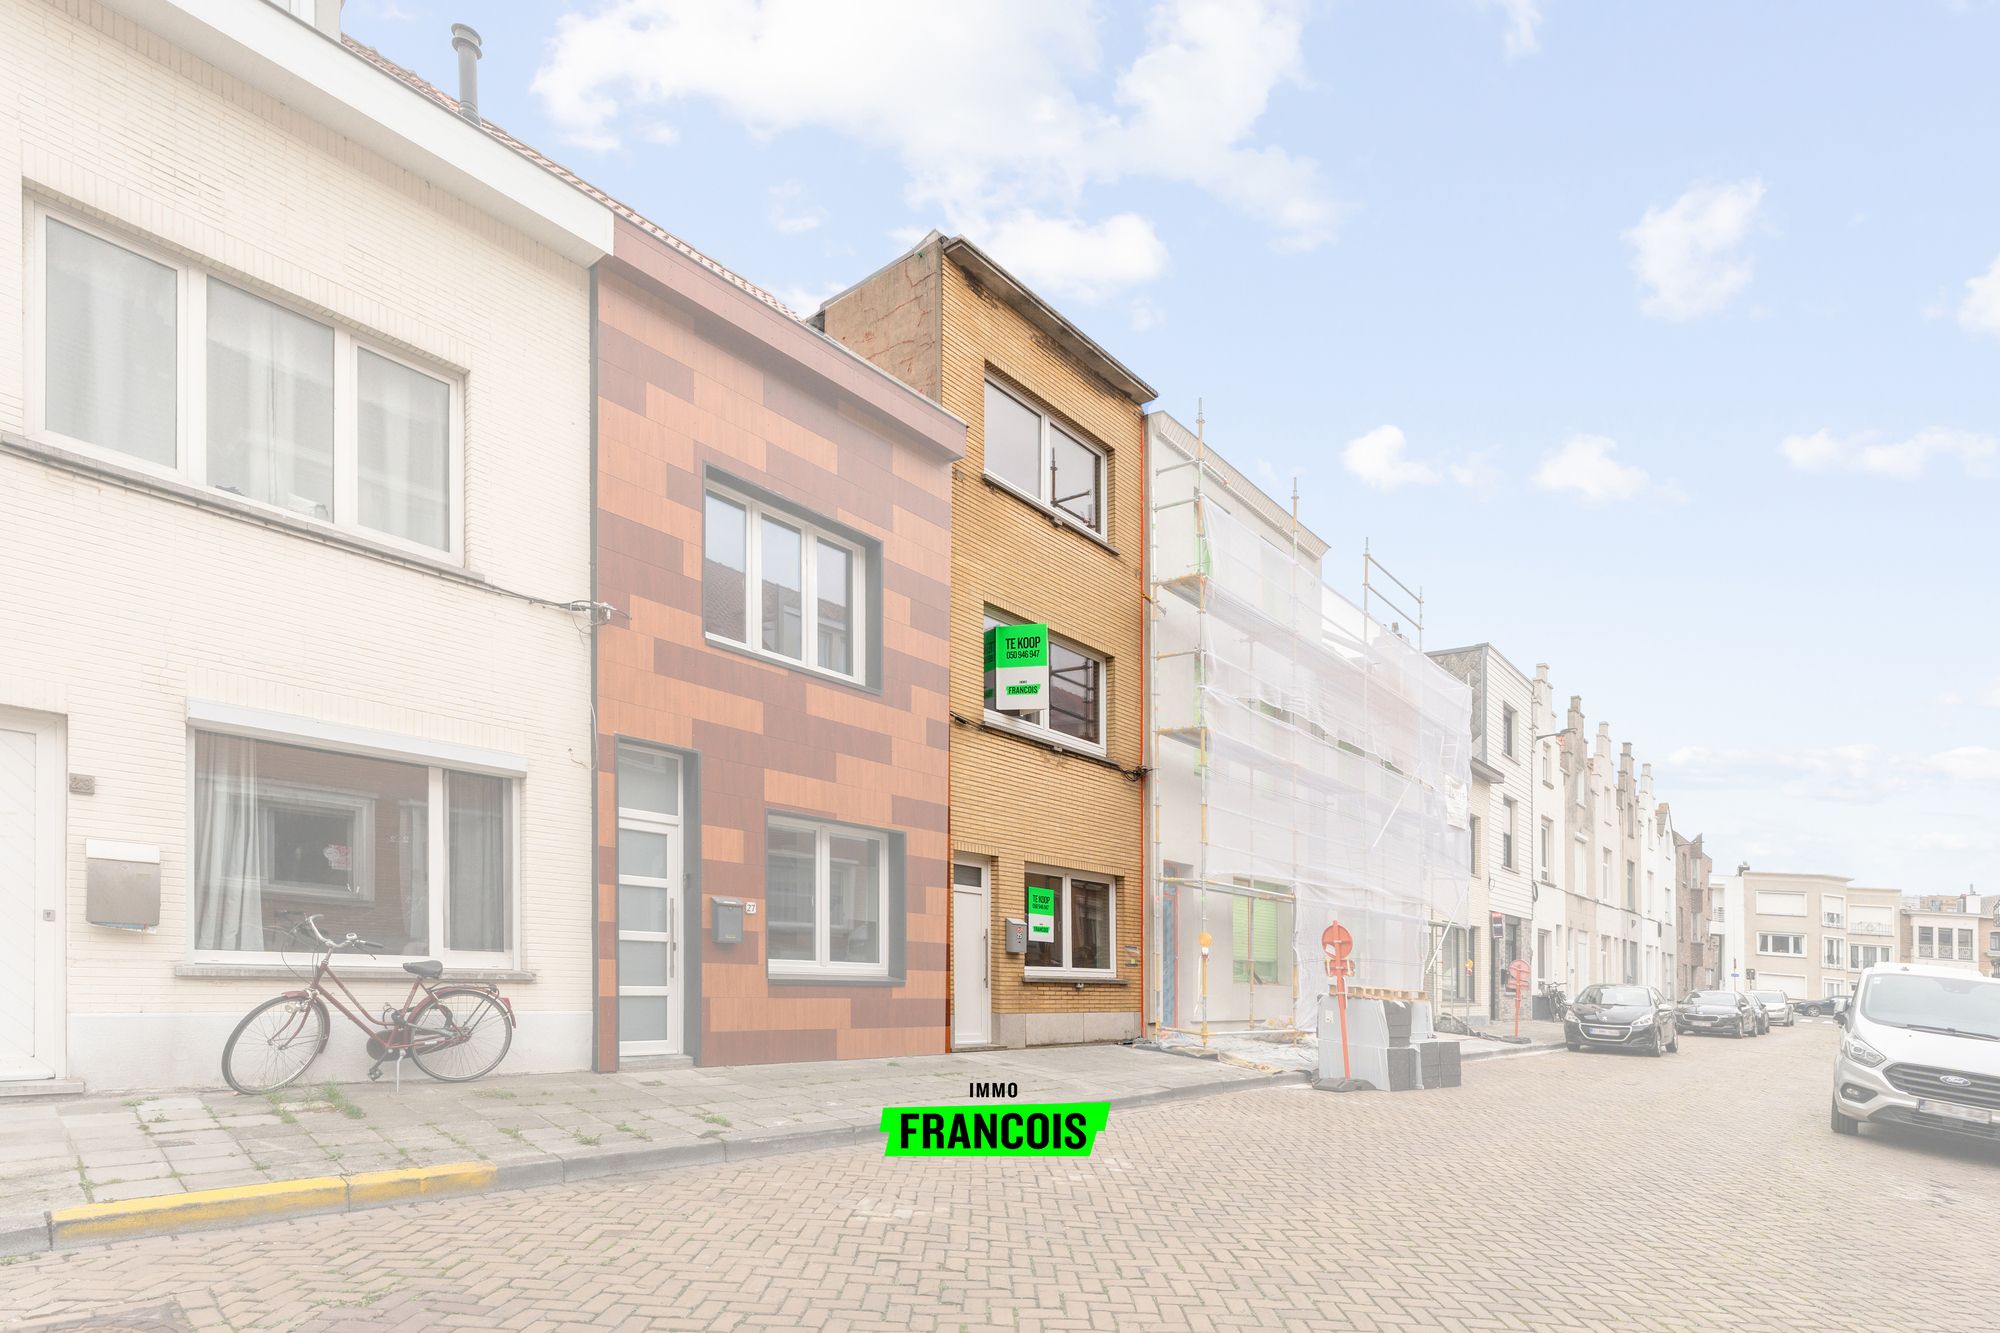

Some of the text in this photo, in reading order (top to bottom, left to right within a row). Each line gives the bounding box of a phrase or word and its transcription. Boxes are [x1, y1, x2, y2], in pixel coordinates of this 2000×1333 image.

[1005, 636, 1041, 649] TE KOOP
[1006, 650, 1040, 659] 050 946 947
[1008, 685, 1038, 695] FRANCOIS
[746, 904, 756, 912] 27
